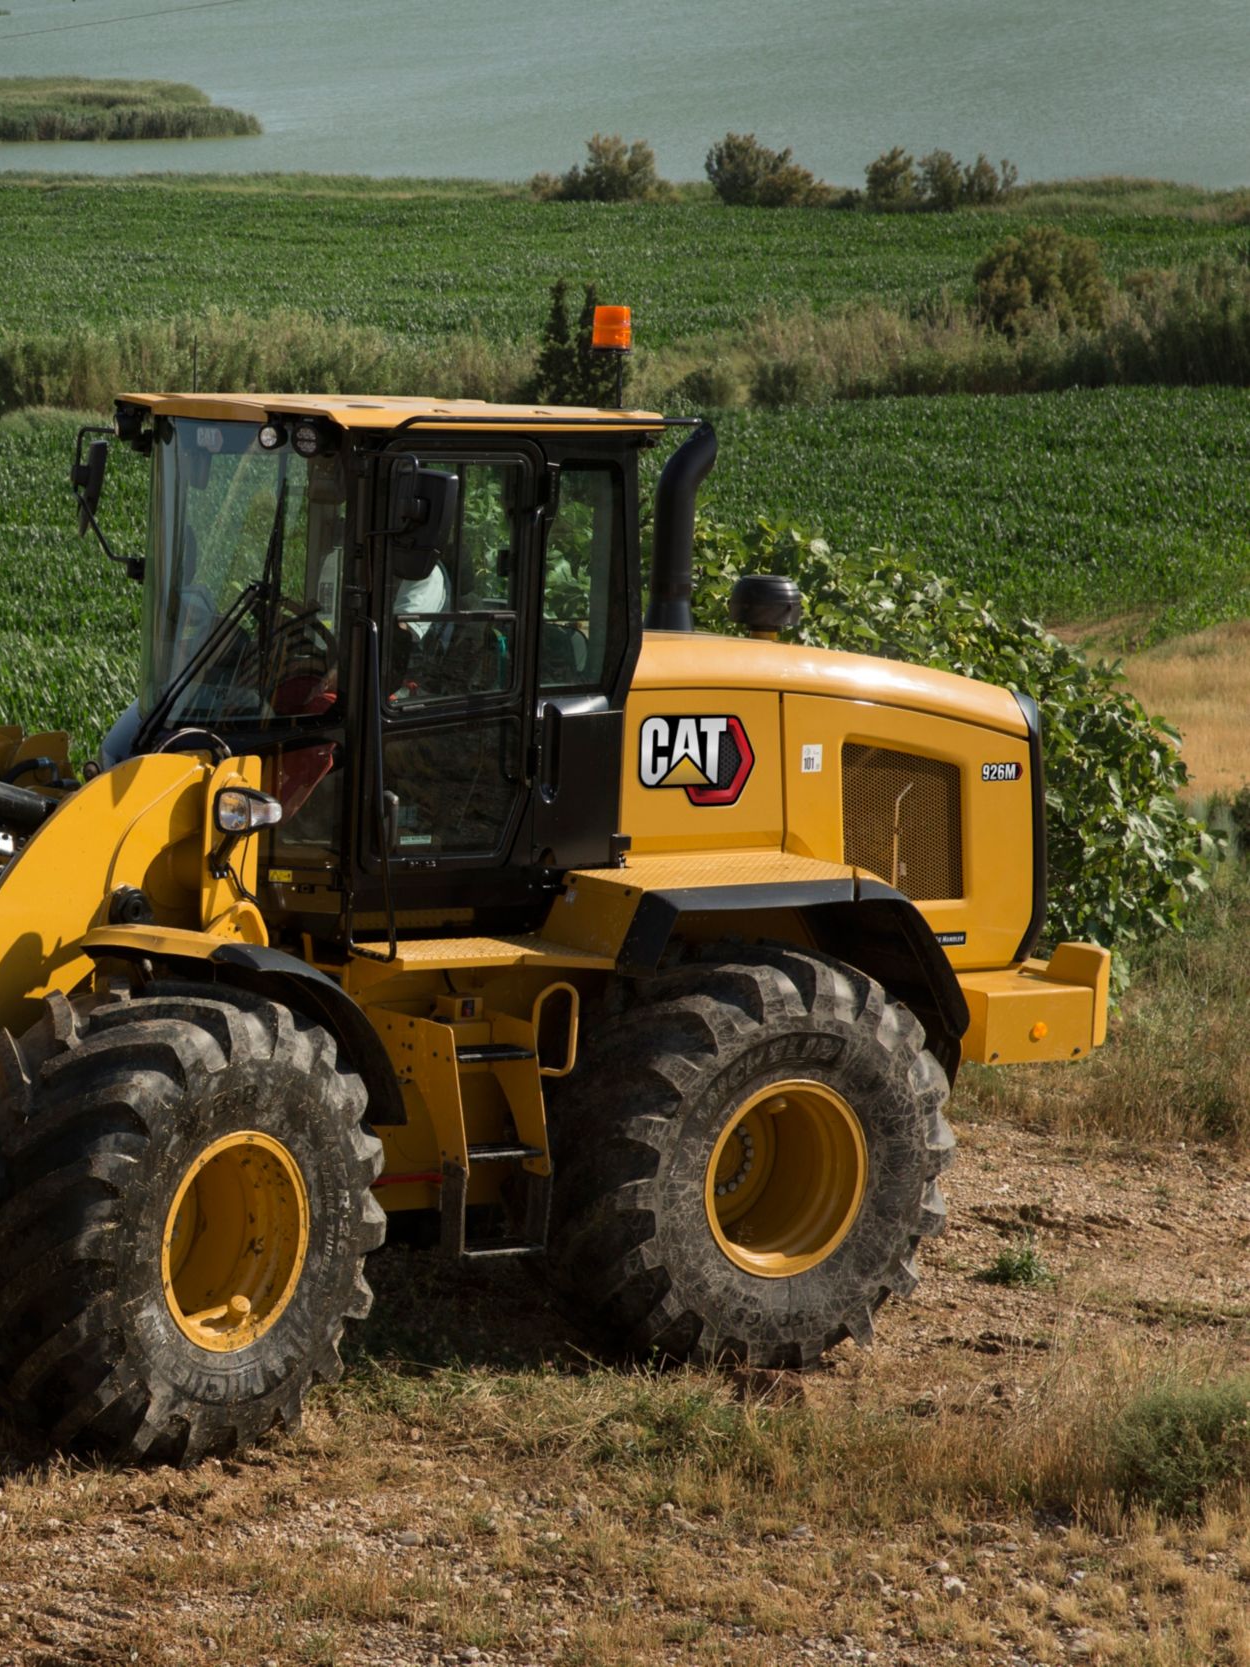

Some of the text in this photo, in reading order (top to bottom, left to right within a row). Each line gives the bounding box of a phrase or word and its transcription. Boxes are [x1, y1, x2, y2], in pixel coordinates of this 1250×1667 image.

[197, 427, 220, 446] CAT
[641, 717, 727, 785] CAT
[804, 756, 815, 770] 101
[982, 764, 1016, 780] 926M
